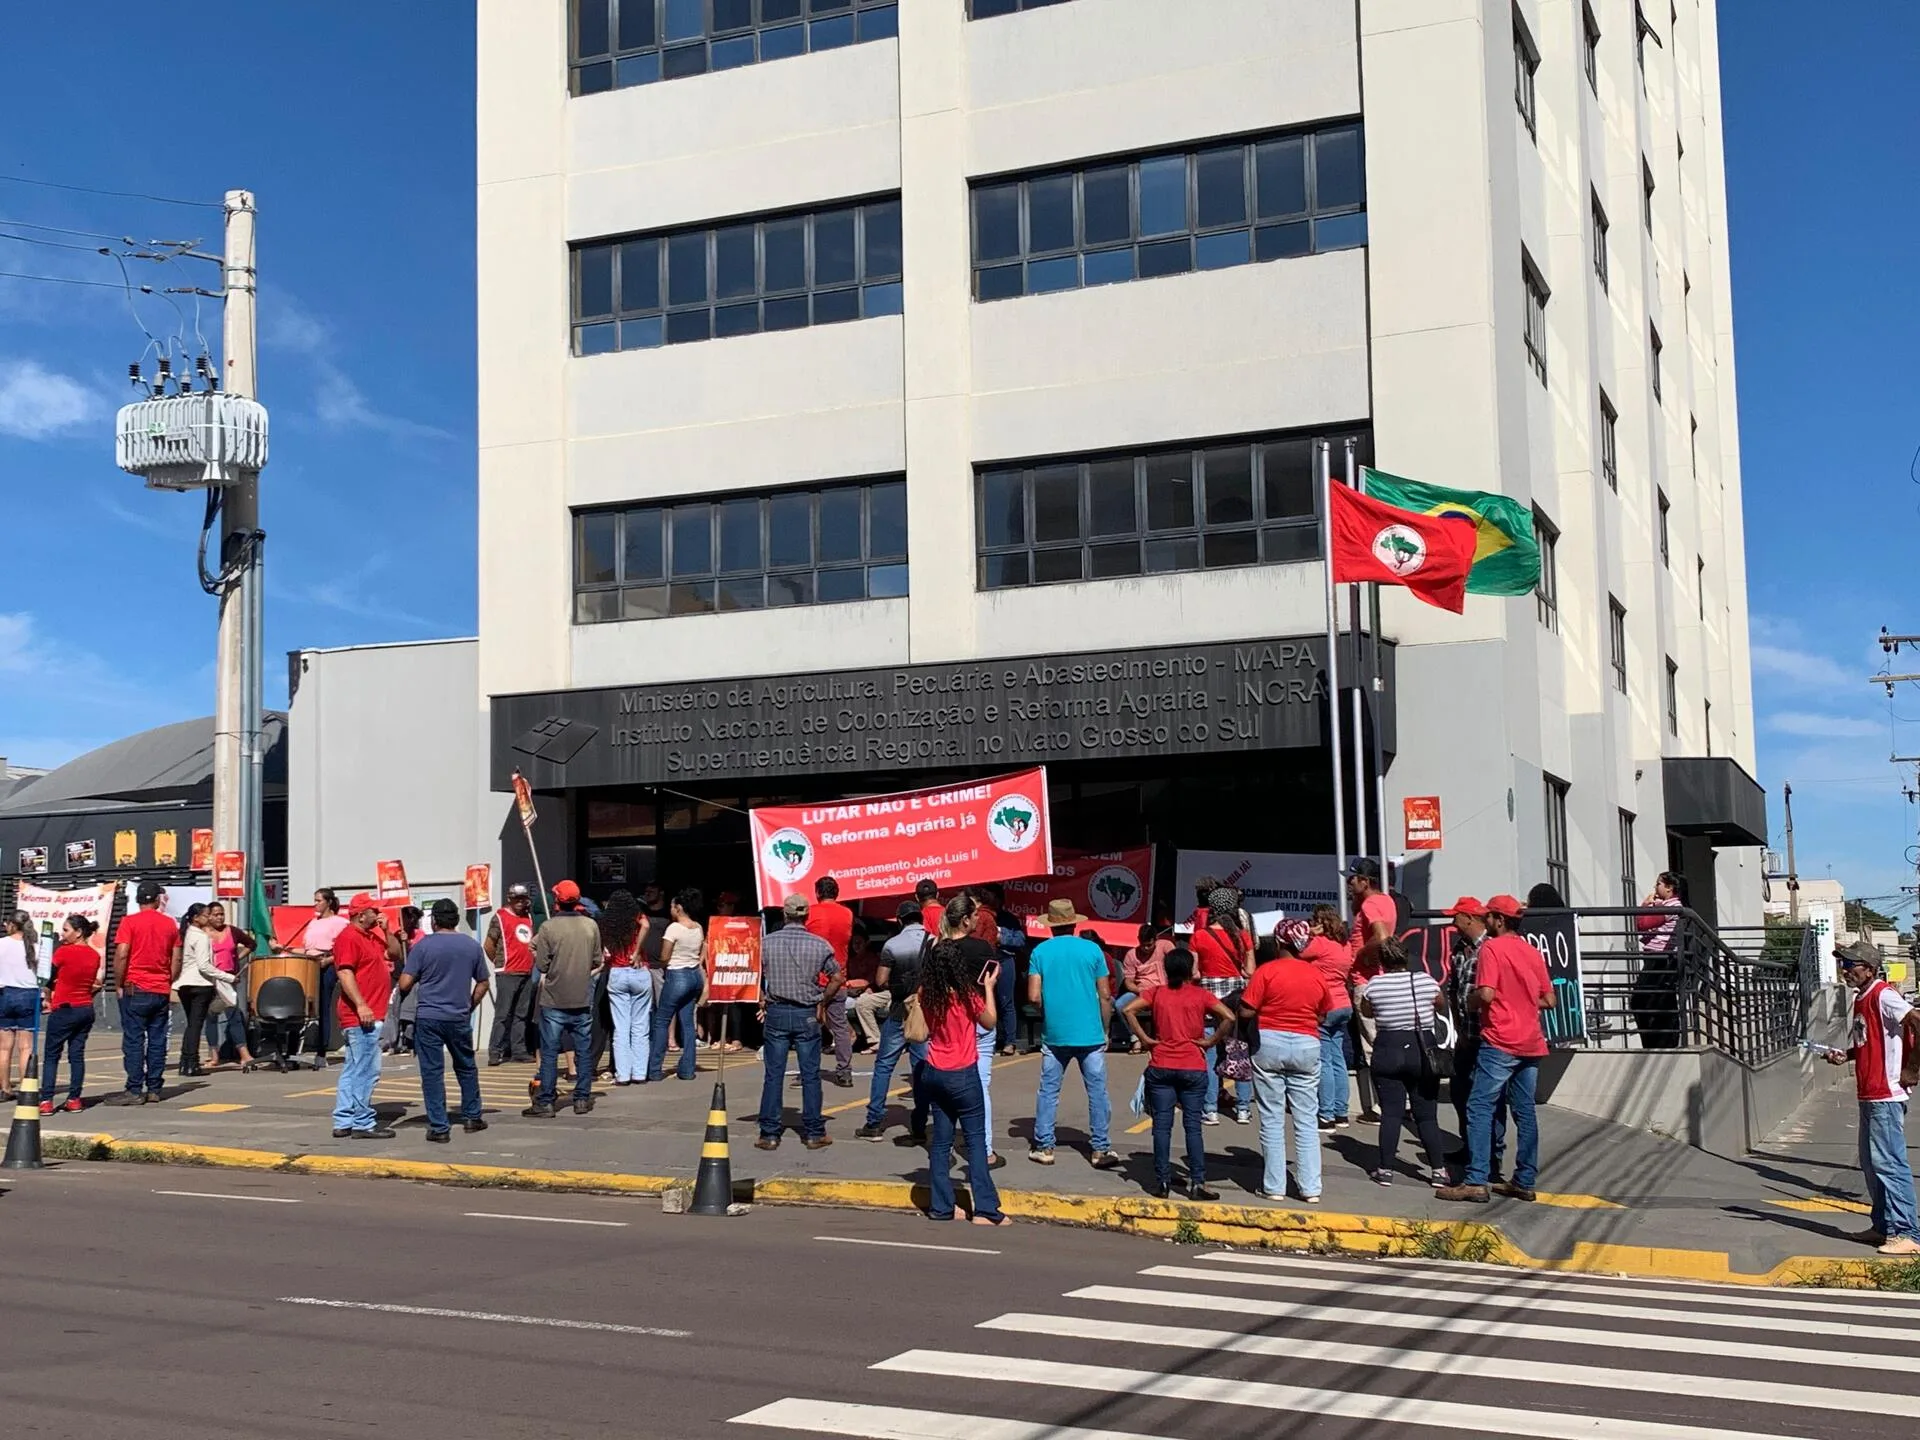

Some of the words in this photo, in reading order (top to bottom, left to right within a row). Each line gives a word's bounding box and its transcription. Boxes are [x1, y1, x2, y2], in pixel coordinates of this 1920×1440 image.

[619, 685, 720, 715] Ministério
[725, 684, 752, 708] da
[759, 679, 884, 712] Agricultura,
[893, 669, 993, 697] Pecuária
[1002, 671, 1017, 690] e
[1024, 652, 1207, 686] Abastecimento
[1233, 642, 1317, 673] MAPA
[611, 720, 694, 748] Instituto
[700, 711, 793, 742] Nacional
[800, 710, 827, 736] de
[836, 699, 978, 734] Colonização
[984, 704, 999, 723] e
[1008, 690, 1111, 722] Reforma
[1116, 685, 1209, 718] Agrária
[1235, 676, 1329, 707] INCRA
[667, 736, 857, 775] Superintendência
[865, 729, 967, 765] Regional
[975, 733, 1002, 756] no
[1011, 724, 1070, 753] Mato
[1080, 720, 1169, 748] Grosso
[1179, 719, 1210, 744] do
[1217, 713, 1260, 741] Sul
[802, 804, 861, 826] LUTAR
[865, 797, 906, 818] NÃO
[911, 793, 923, 811] É
[931, 784, 992, 808] CRIME!
[821, 825, 890, 847] Reforma
[894, 815, 956, 839] Agrária
[959, 811, 977, 832] já
[827, 858, 912, 880] Acampamento
[914, 853, 943, 870] João
[945, 850, 971, 865] Luis
[856, 872, 904, 892] Estação
[906, 867, 952, 884] Guavira
[1299, 890, 1338, 900] ALEXANDR
[714, 952, 750, 968] OCUPAR
[711, 971, 758, 987] ALIMENTAR
